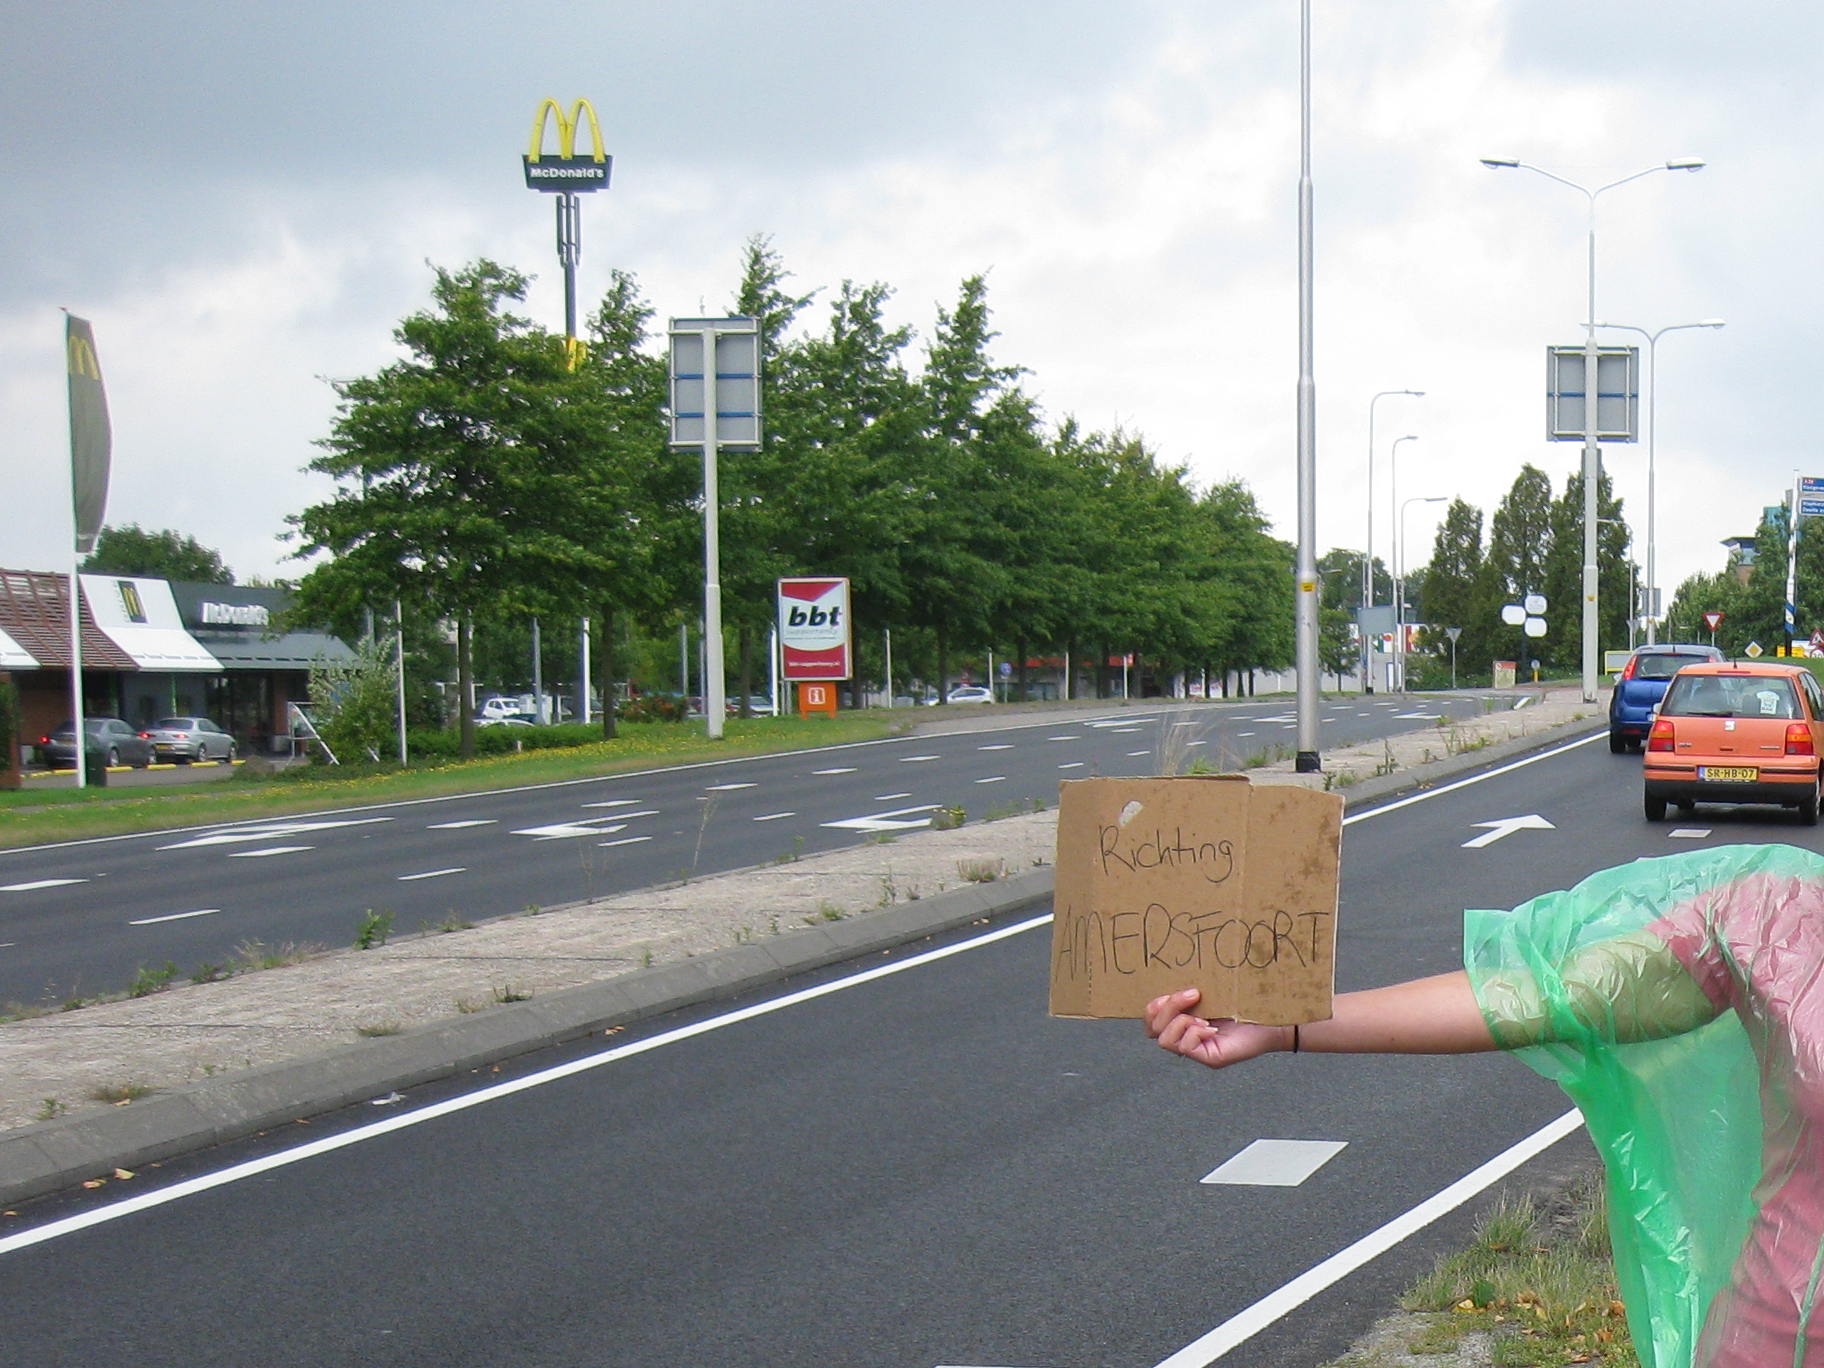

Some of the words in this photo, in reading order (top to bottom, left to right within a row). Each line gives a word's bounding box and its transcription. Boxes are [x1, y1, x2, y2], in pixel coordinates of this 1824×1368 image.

[530, 168, 604, 178] McDonald's
[788, 606, 842, 627] bbt
[1706, 768, 1755, 779] SR-HB-07
[1099, 825, 1234, 883] Richting
[1056, 903, 1329, 982] AMERSFOORT
